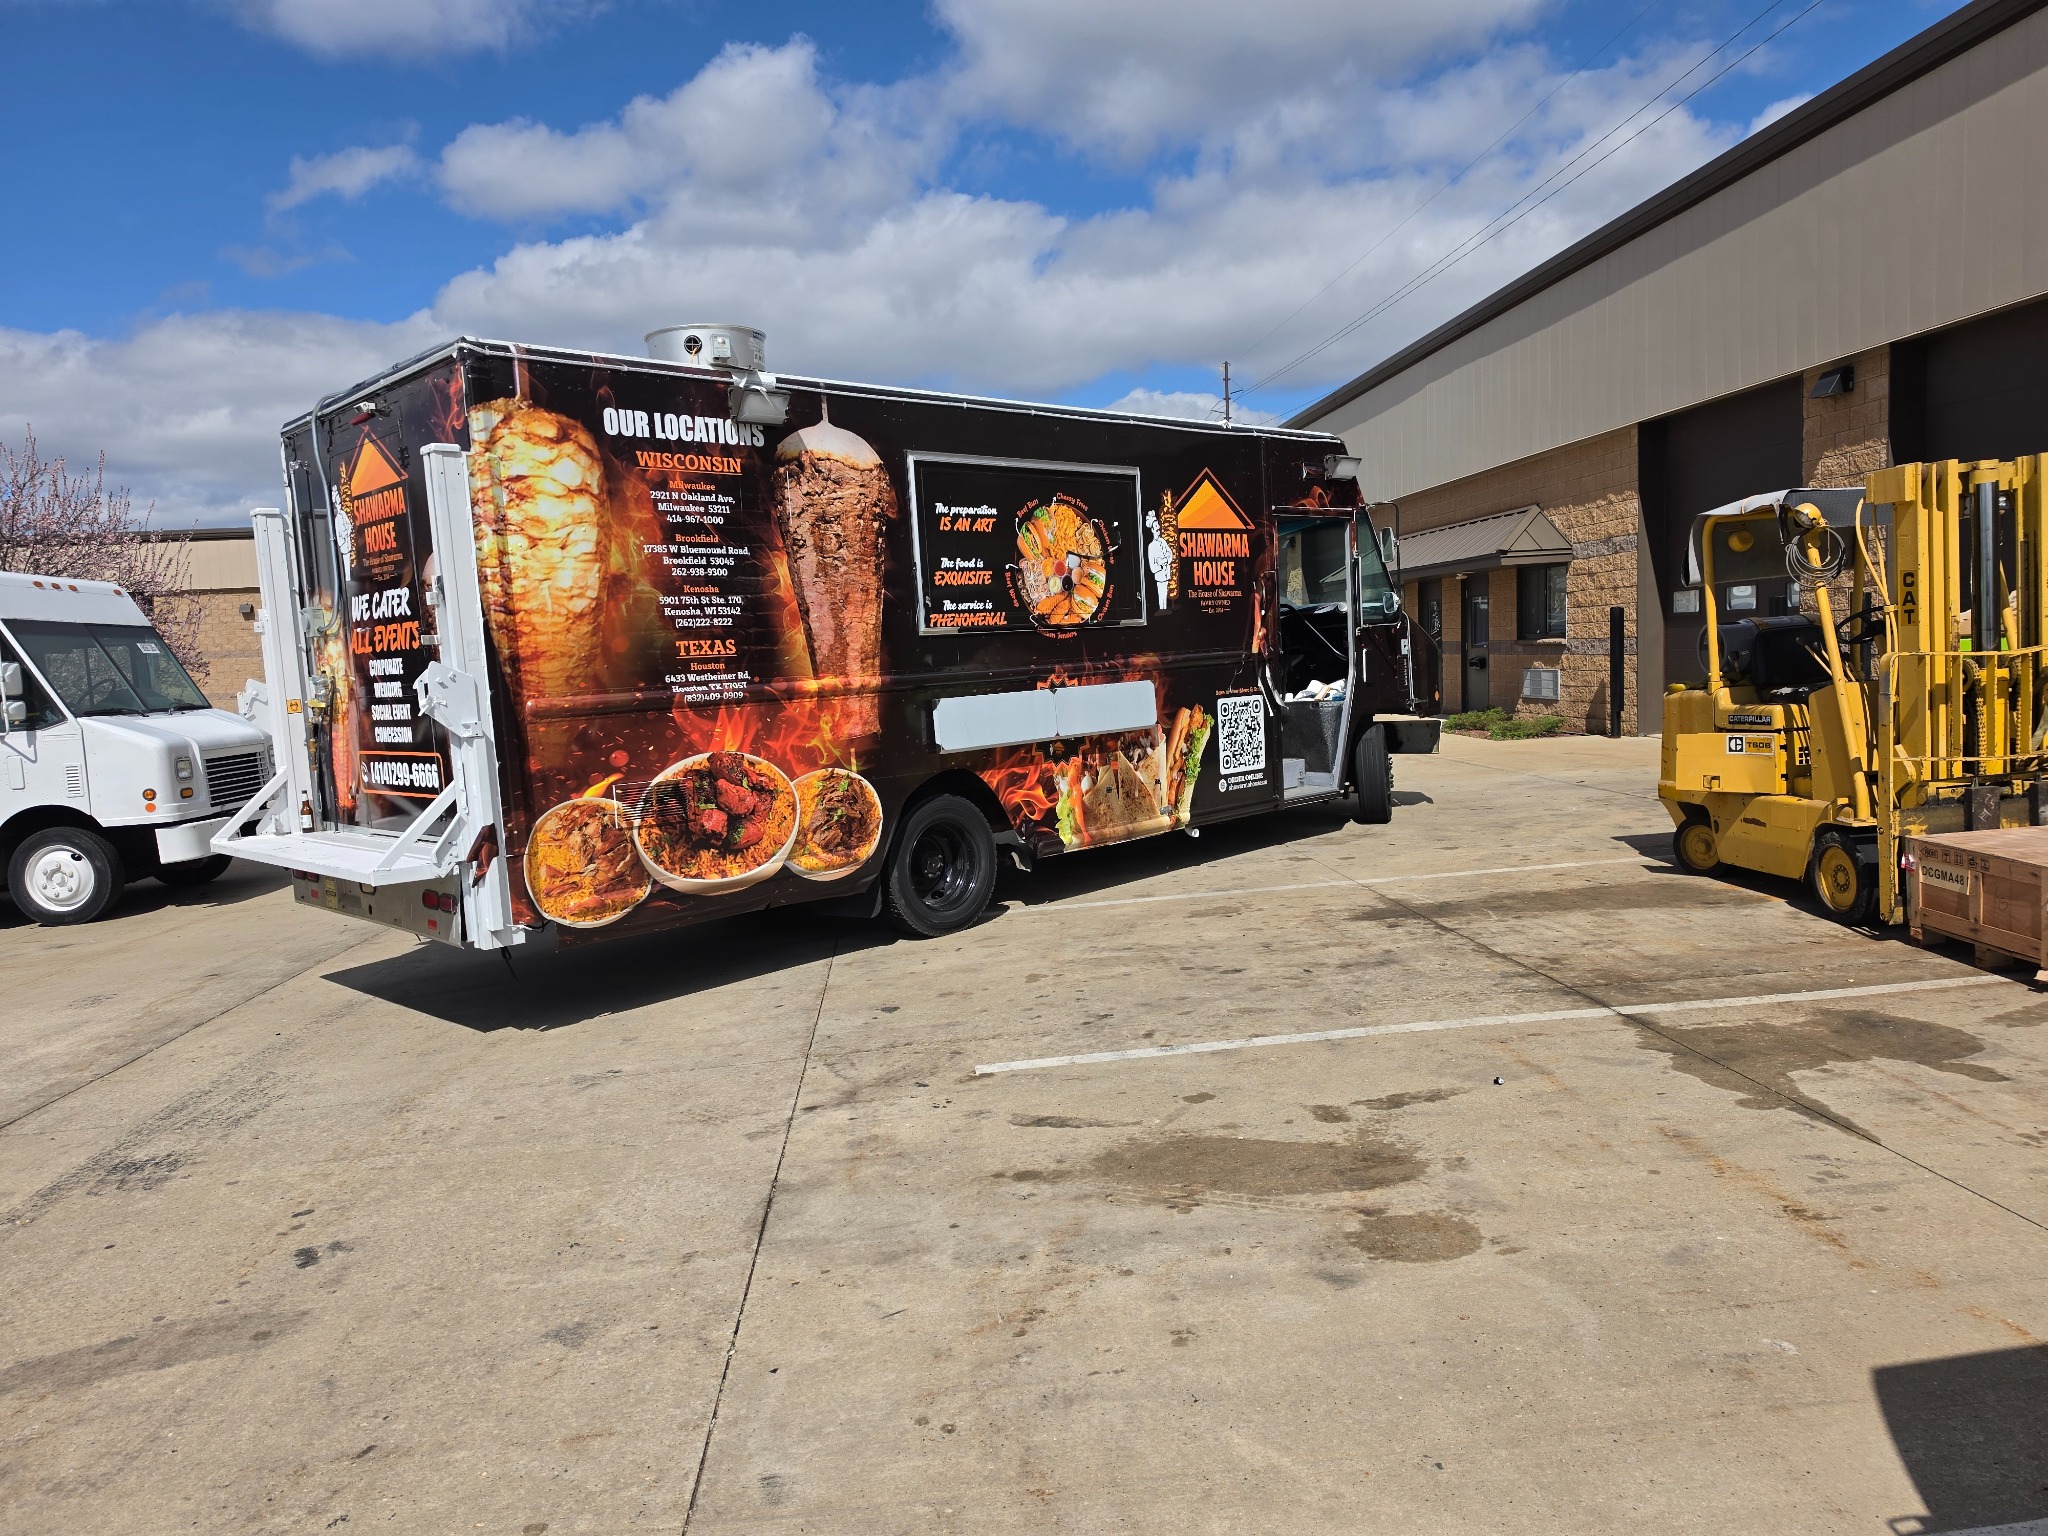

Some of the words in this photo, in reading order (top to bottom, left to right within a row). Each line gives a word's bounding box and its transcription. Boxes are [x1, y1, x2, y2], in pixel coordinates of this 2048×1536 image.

[603, 407, 650, 438] OUR
[653, 412, 765, 447] LOCATIONS
[635, 450, 742, 473] WISCONSIN
[669, 481, 716, 491] Milwaukee
[650, 491, 670, 500] 2921
[672, 492, 679, 500] N
[681, 492, 716, 502] Oakland
[717, 494, 736, 504] Ave,
[353, 487, 406, 526] SHAWARMA
[657, 502, 705, 513] Milwaukee
[708, 505, 731, 514] 53211
[935, 502, 949, 515] The
[949, 504, 998, 517] preparation
[666, 514, 724, 525] 414-967-1000
[939, 516, 952, 531] IS
[953, 517, 972, 532] AN
[972, 518, 997, 533] ART
[364, 521, 397, 554] HOUSE
[675, 533, 719, 543] Brookfield
[643, 545, 668, 553] 17385
[669, 545, 679, 553] W
[680, 545, 727, 554] Bluemound
[1179, 532, 1250, 558] SHAWARMA
[662, 556, 707, 565] Brookfield
[710, 557, 735, 566] 53045
[940, 557, 955, 569] The
[955, 557, 976, 571] food
[976, 558, 984, 568] is
[671, 567, 728, 577] 262-938-9300
[933, 570, 993, 587] EXQUISITE
[1193, 560, 1236, 586] HOUSE
[683, 584, 720, 593] Kenosha
[351, 593, 371, 623] WE
[371, 586, 412, 620] CATER
[659, 596, 680, 605] 5901
[680, 596, 700, 605] 75th
[700, 596, 711, 605] St
[1902, 571, 1917, 625] CAT
[663, 607, 704, 617] Kenosha,
[704, 606, 717, 615] WI
[717, 606, 742, 615] 53142
[943, 599, 957, 612] The
[957, 600, 985, 611] service
[985, 599, 993, 610] is
[675, 617, 733, 629] (262)222-8222
[929, 611, 1008, 628] PHENOMENAL
[351, 628, 373, 655] ALL
[373, 620, 420, 653] EVENTS
[675, 639, 737, 656] TEXAS
[368, 657, 404, 677] CORPORATE
[690, 662, 726, 671] Houston
[664, 674, 686, 683] 6433
[686, 671, 737, 682] Westheimer
[373, 681, 403, 699] WEDDING
[671, 685, 709, 693] Houston
[709, 683, 723, 691] TX
[723, 681, 748, 690] 77057
[684, 691, 744, 704] (832)409-0909
[371, 704, 394, 721] SOCIAL
[392, 703, 412, 721] EVENT
[1729, 715, 1771, 723] CATERPILLAR
[374, 726, 413, 743] CONCESSION
[1746, 741, 1772, 749] T60B
[369, 761, 440, 789] (414)299-6666
[1921, 865, 1965, 886] DCGMA48
